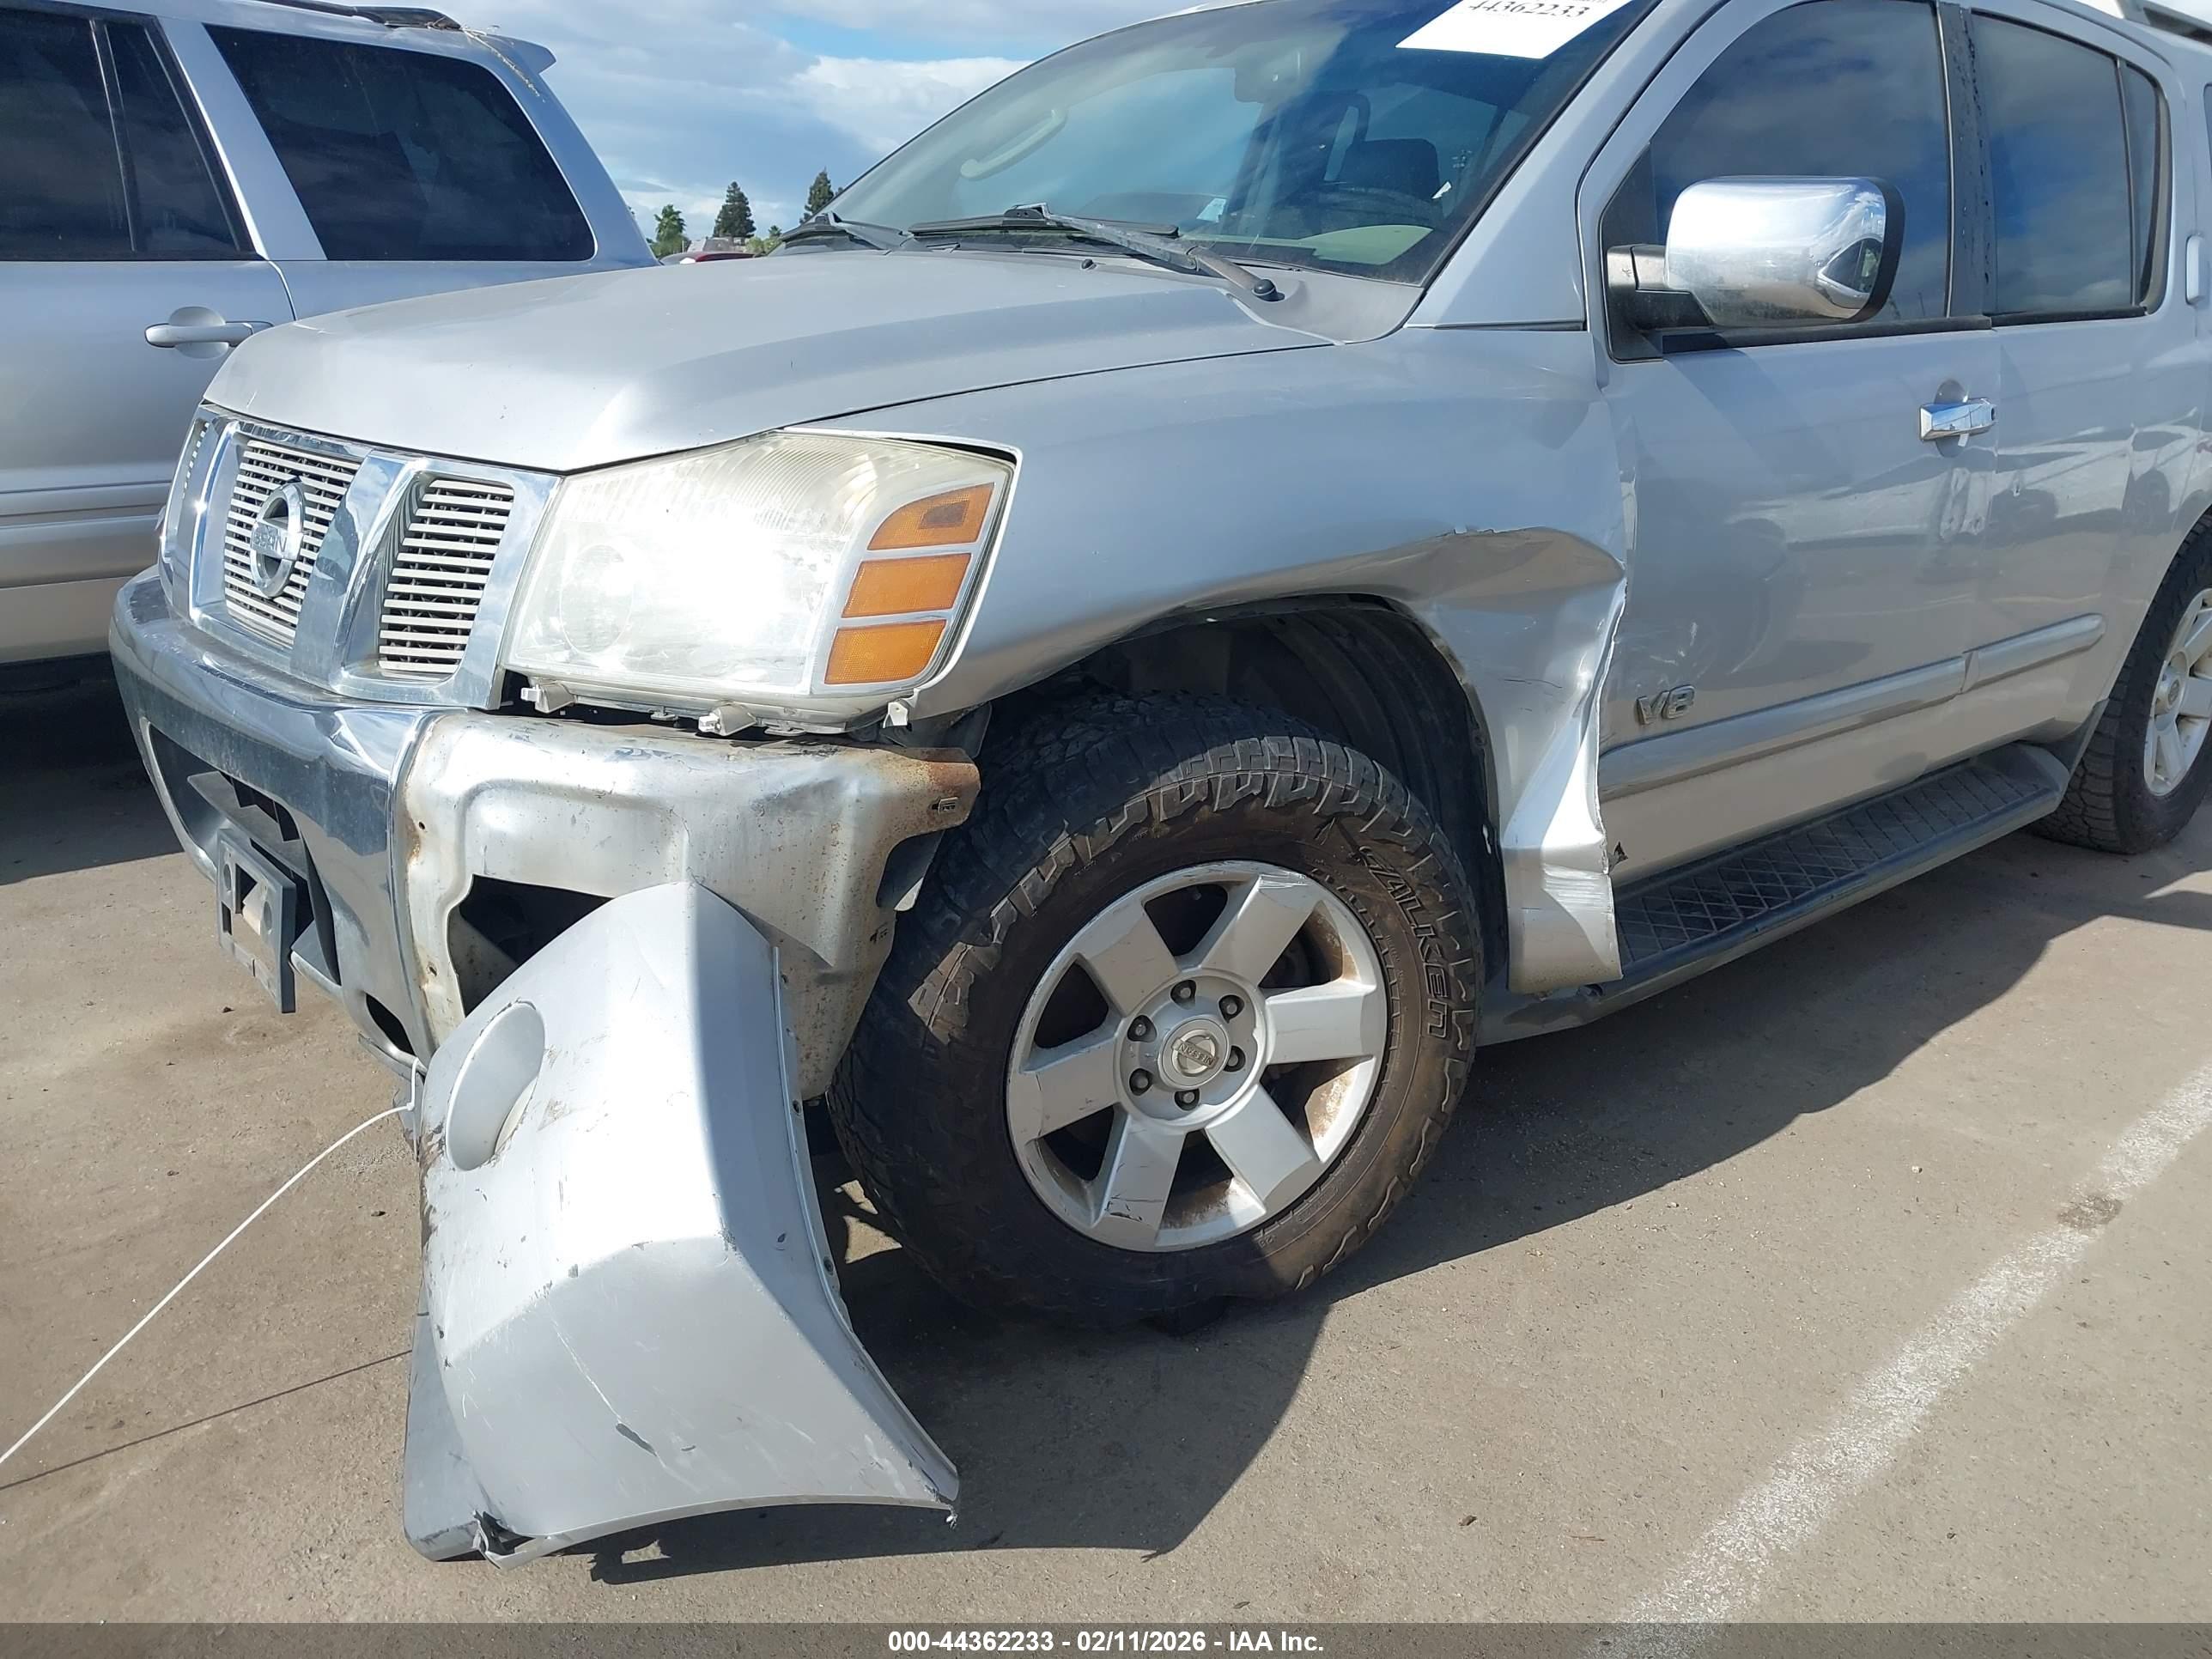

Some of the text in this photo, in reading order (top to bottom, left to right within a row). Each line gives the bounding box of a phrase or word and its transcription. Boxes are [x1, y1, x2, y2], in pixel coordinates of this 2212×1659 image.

[1468, 0, 1590, 18] 44362233
[1635, 684, 1695, 725] V8
[1358, 845, 1449, 1039] FALKEN
[1177, 1043, 1215, 1066] NISSAN
